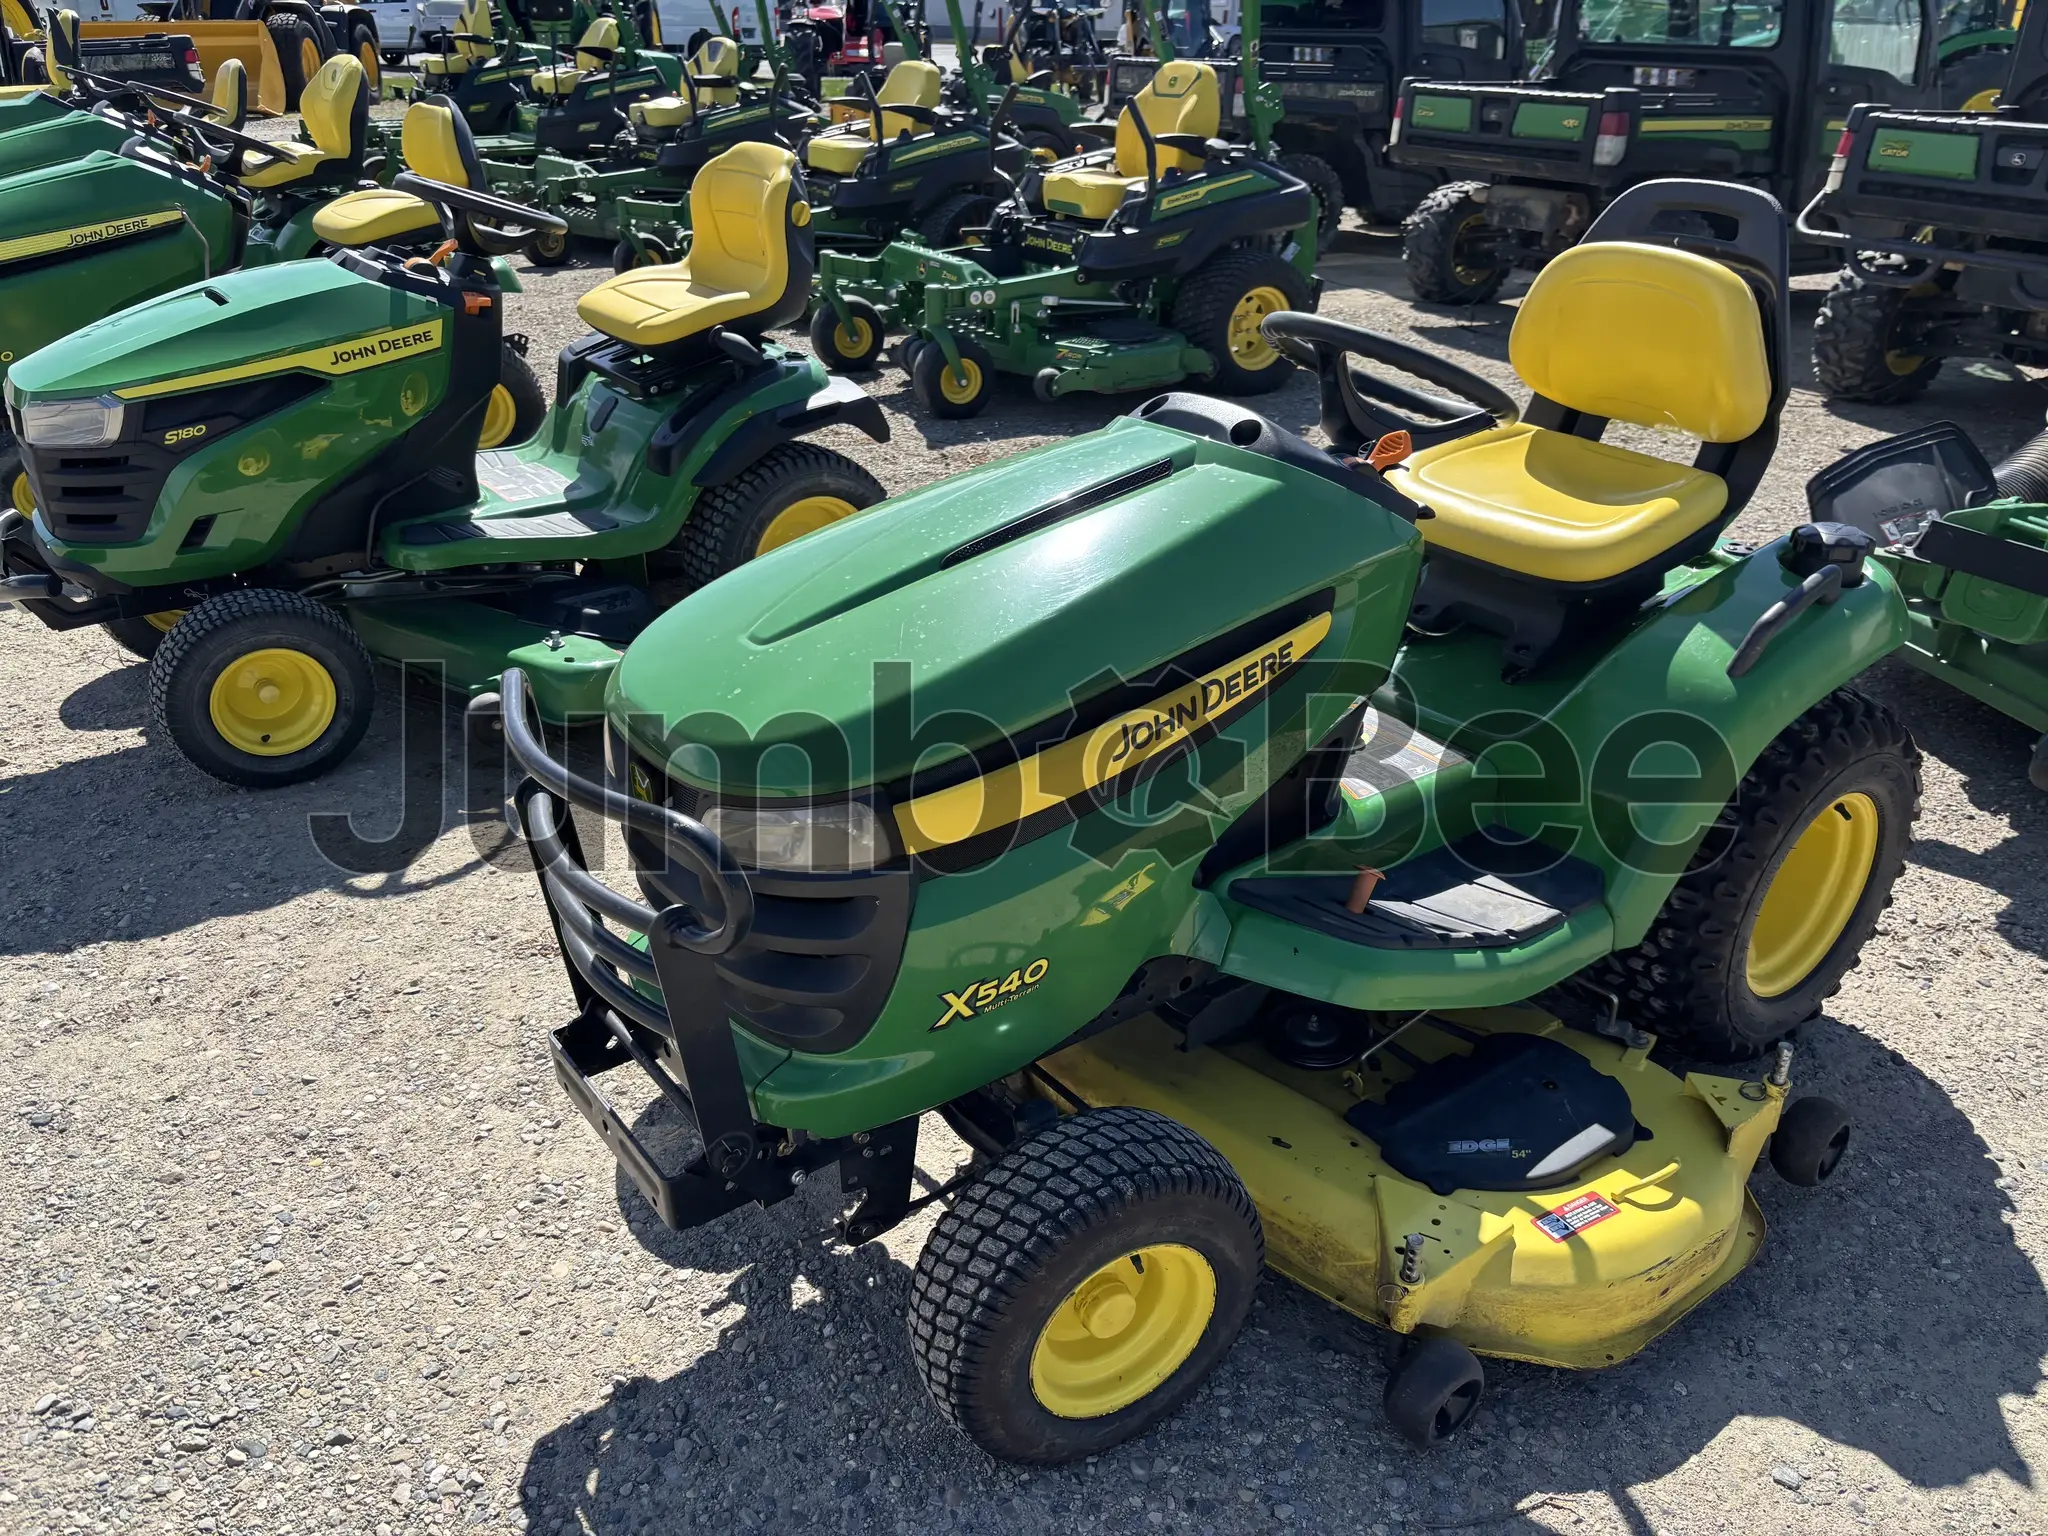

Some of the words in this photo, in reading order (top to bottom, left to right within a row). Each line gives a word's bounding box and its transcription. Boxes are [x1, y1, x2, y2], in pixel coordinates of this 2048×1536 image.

[68, 229, 104, 247] JOHN
[106, 218, 149, 236] DEERE
[1025, 233, 1046, 249] JOHN
[1046, 238, 1073, 254] DEERE
[330, 344, 377, 366] JOHN
[378, 330, 434, 353] DEERE
[163, 424, 206, 445] S180
[1111, 695, 1198, 763] JOHN
[1201, 640, 1295, 715] DEERE
[929, 957, 1050, 1032] X540
[1446, 1138, 1510, 1154] EDGE
[1511, 1149, 1532, 1159] 54"
